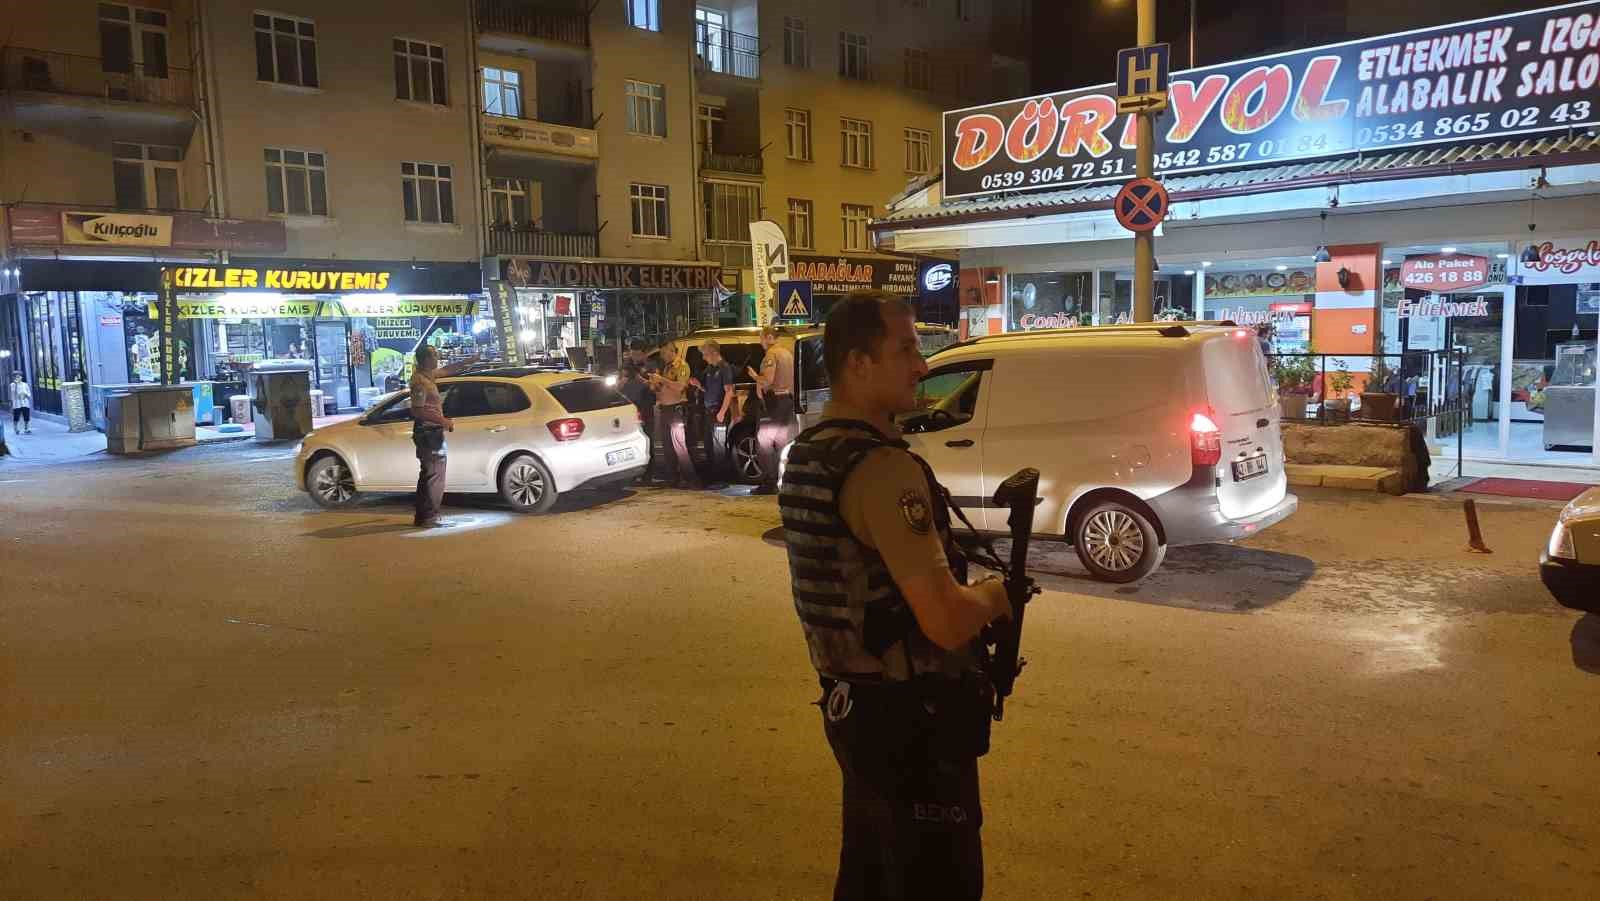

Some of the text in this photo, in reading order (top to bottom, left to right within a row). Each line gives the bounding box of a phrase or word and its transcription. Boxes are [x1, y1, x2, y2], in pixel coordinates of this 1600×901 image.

[1355, 66, 1508, 118] ALABALIK
[952, 55, 1351, 171] DÖRYOL
[981, 172, 1025, 190] 0539
[1030, 168, 1066, 184] 304
[1071, 163, 1095, 179] 72
[1099, 158, 1124, 175] 51
[1207, 143, 1251, 163] 587
[1357, 120, 1425, 145] 0534
[1433, 112, 1491, 137] 865
[1500, 106, 1540, 128] 02
[1550, 100, 1592, 123] 43
[94, 222, 158, 238] Kılıçoğlu
[1405, 271, 1483, 284] 426 18 88
[1414, 259, 1475, 269] Alo Paket
